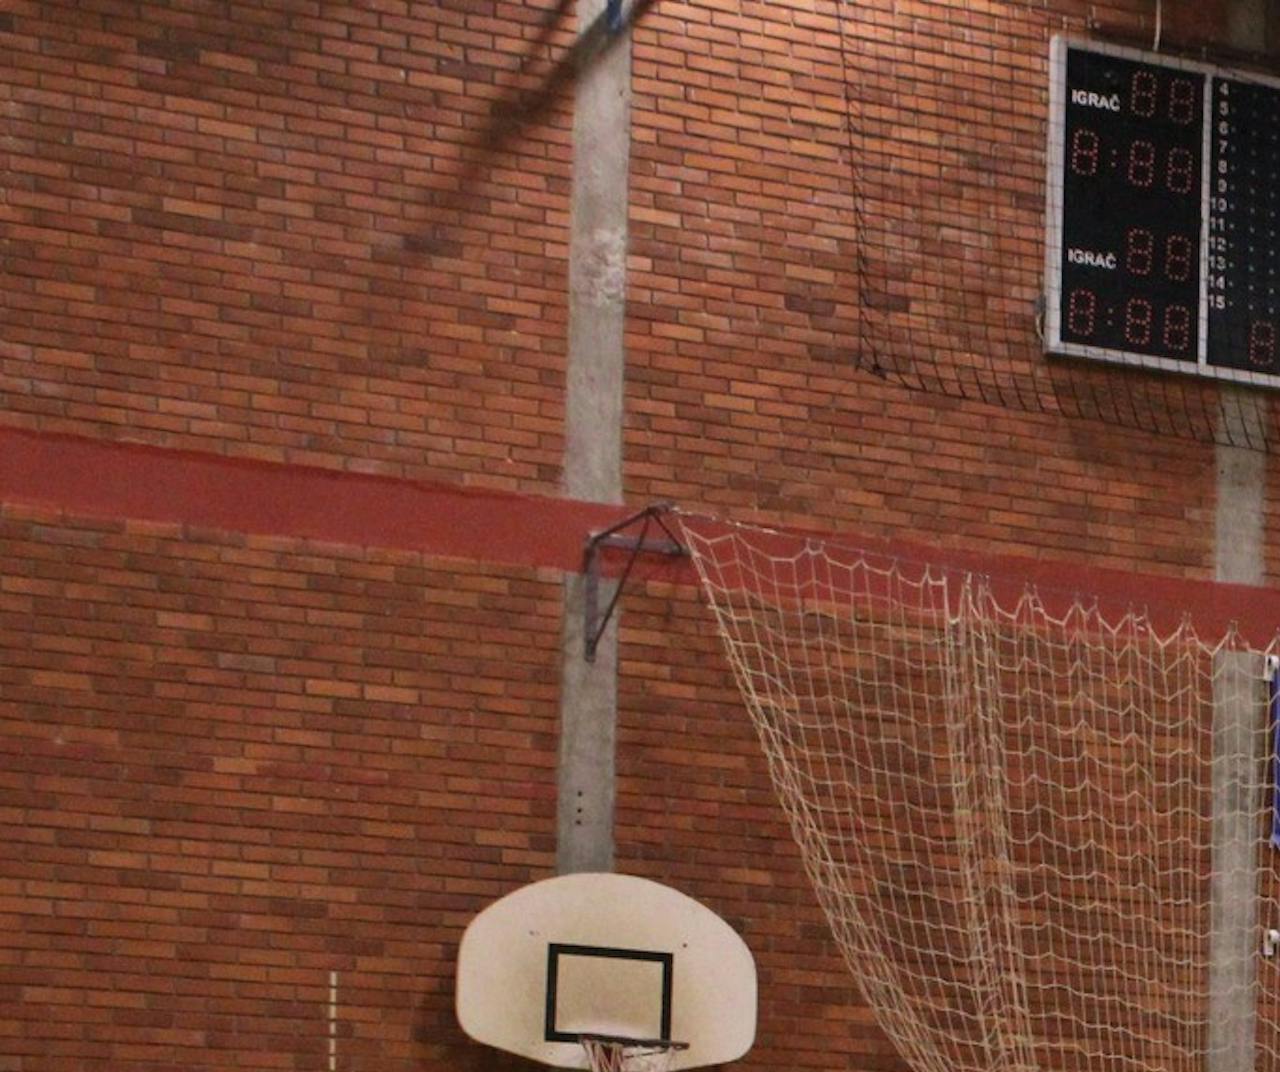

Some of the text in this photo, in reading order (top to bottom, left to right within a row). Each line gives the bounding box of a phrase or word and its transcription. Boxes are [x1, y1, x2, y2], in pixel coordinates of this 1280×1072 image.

[1219, 82, 1229, 96] 4
[1071, 88, 1120, 113] IGRAČ
[1218, 140, 1228, 154] 7
[1217, 160, 1228, 174] 8
[1210, 198, 1228, 213] 10
[1209, 216, 1226, 232] 11
[1209, 236, 1227, 252] 12
[1067, 247, 1117, 270] IGRAČ
[1208, 255, 1226, 271] 13
[1208, 275, 1226, 290] 14
[1208, 294, 1226, 310] 15
